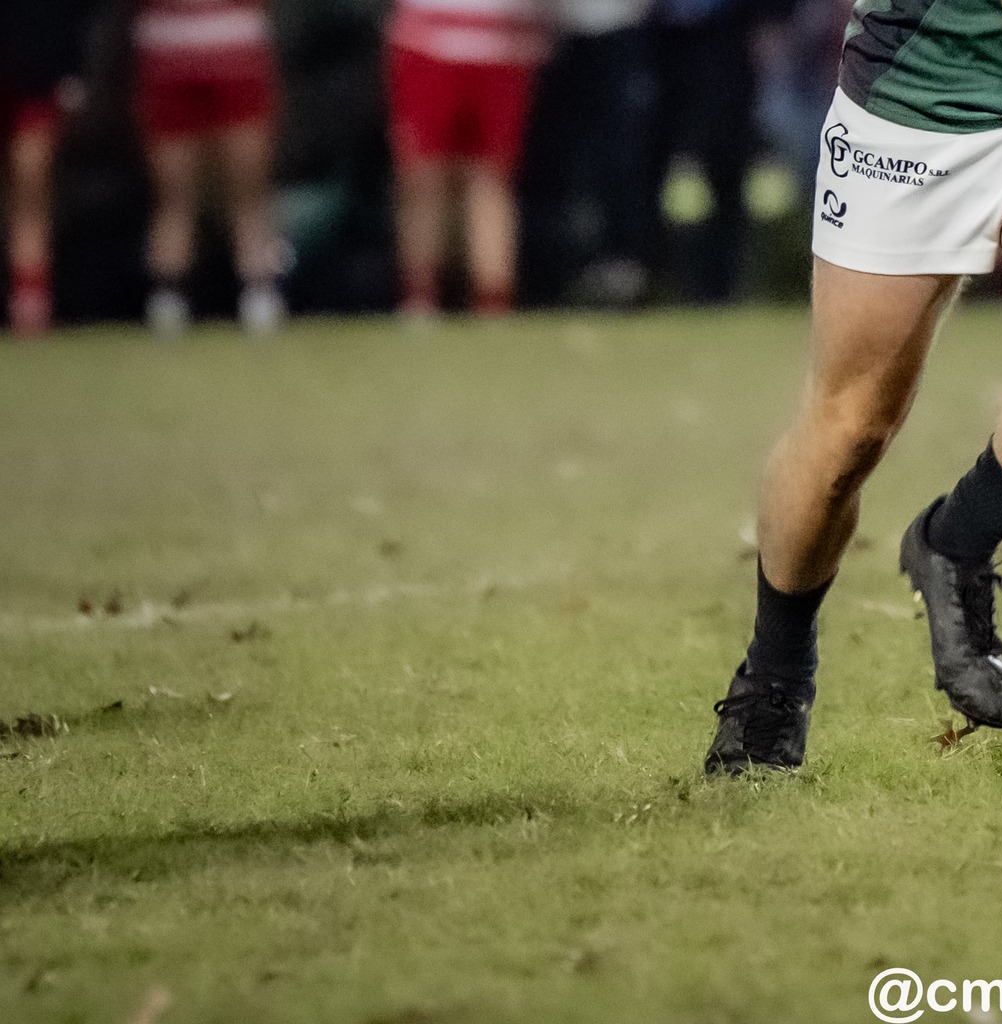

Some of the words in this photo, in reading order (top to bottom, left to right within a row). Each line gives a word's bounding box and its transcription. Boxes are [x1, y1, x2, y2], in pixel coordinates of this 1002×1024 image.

[853, 149, 928, 176] GCAMPO
[851, 163, 924, 187] MAQUINARIAS
[820, 211, 844, 229] quince
